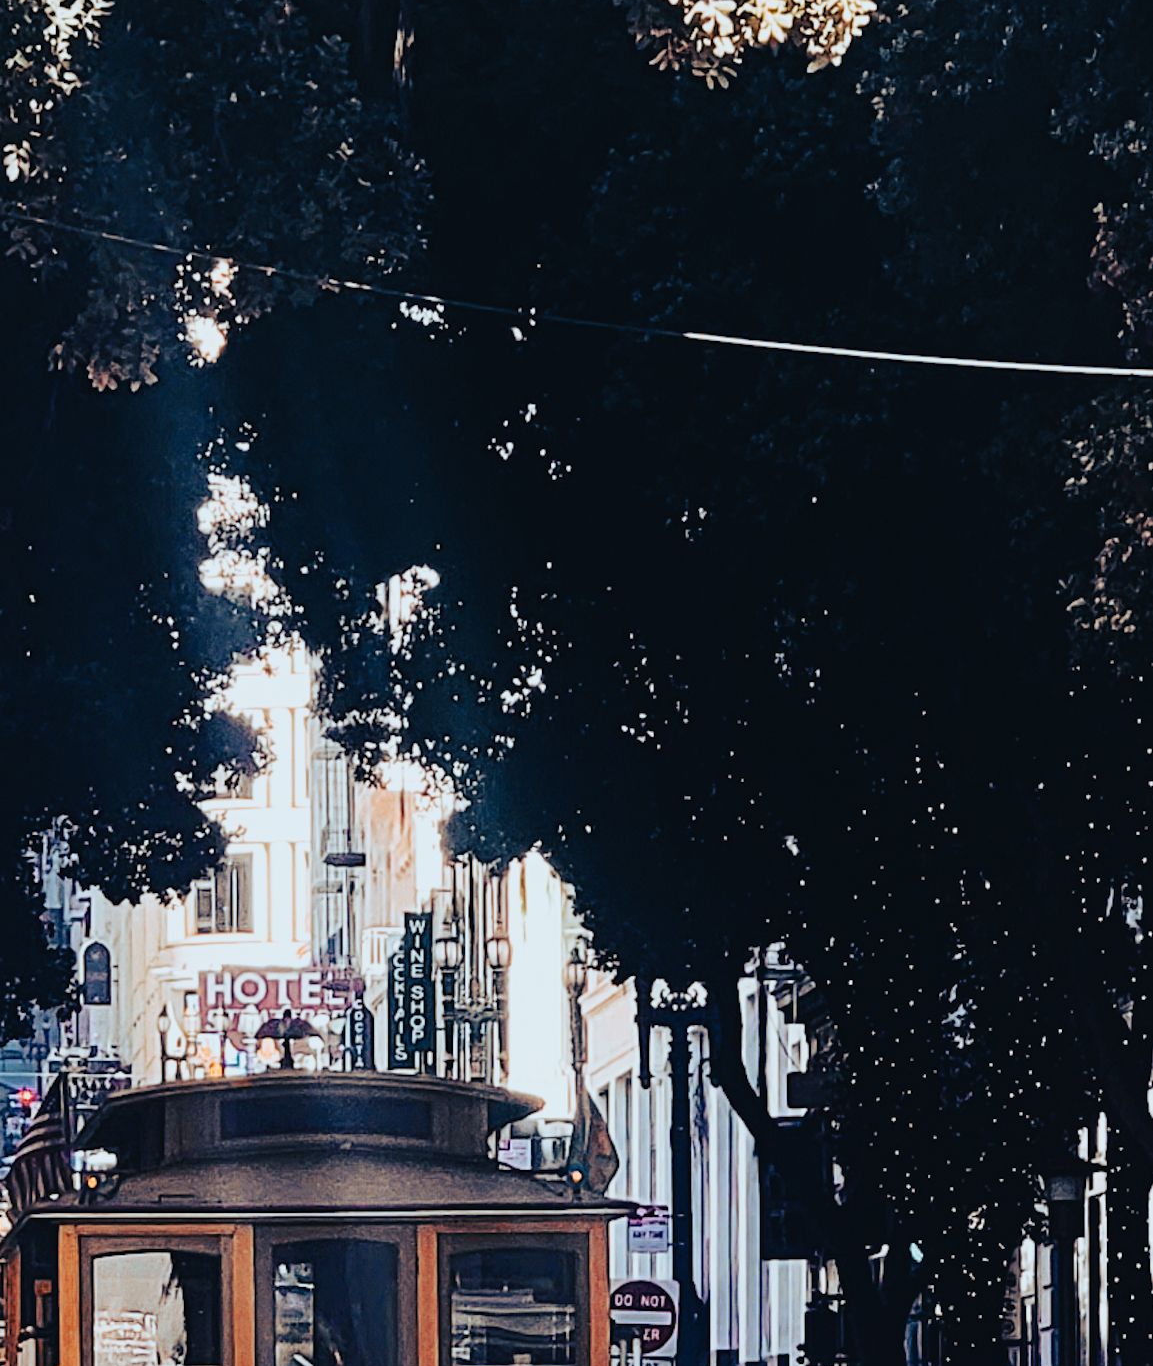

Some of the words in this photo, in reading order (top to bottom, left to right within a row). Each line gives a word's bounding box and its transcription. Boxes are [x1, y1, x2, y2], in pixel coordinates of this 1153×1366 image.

[409, 919, 426, 979] WINE
[205, 971, 346, 1006] HOTEL
[410, 985, 426, 1044] SHOP
[614, 1294, 633, 1307] DO
[641, 1295, 666, 1308] NOT
